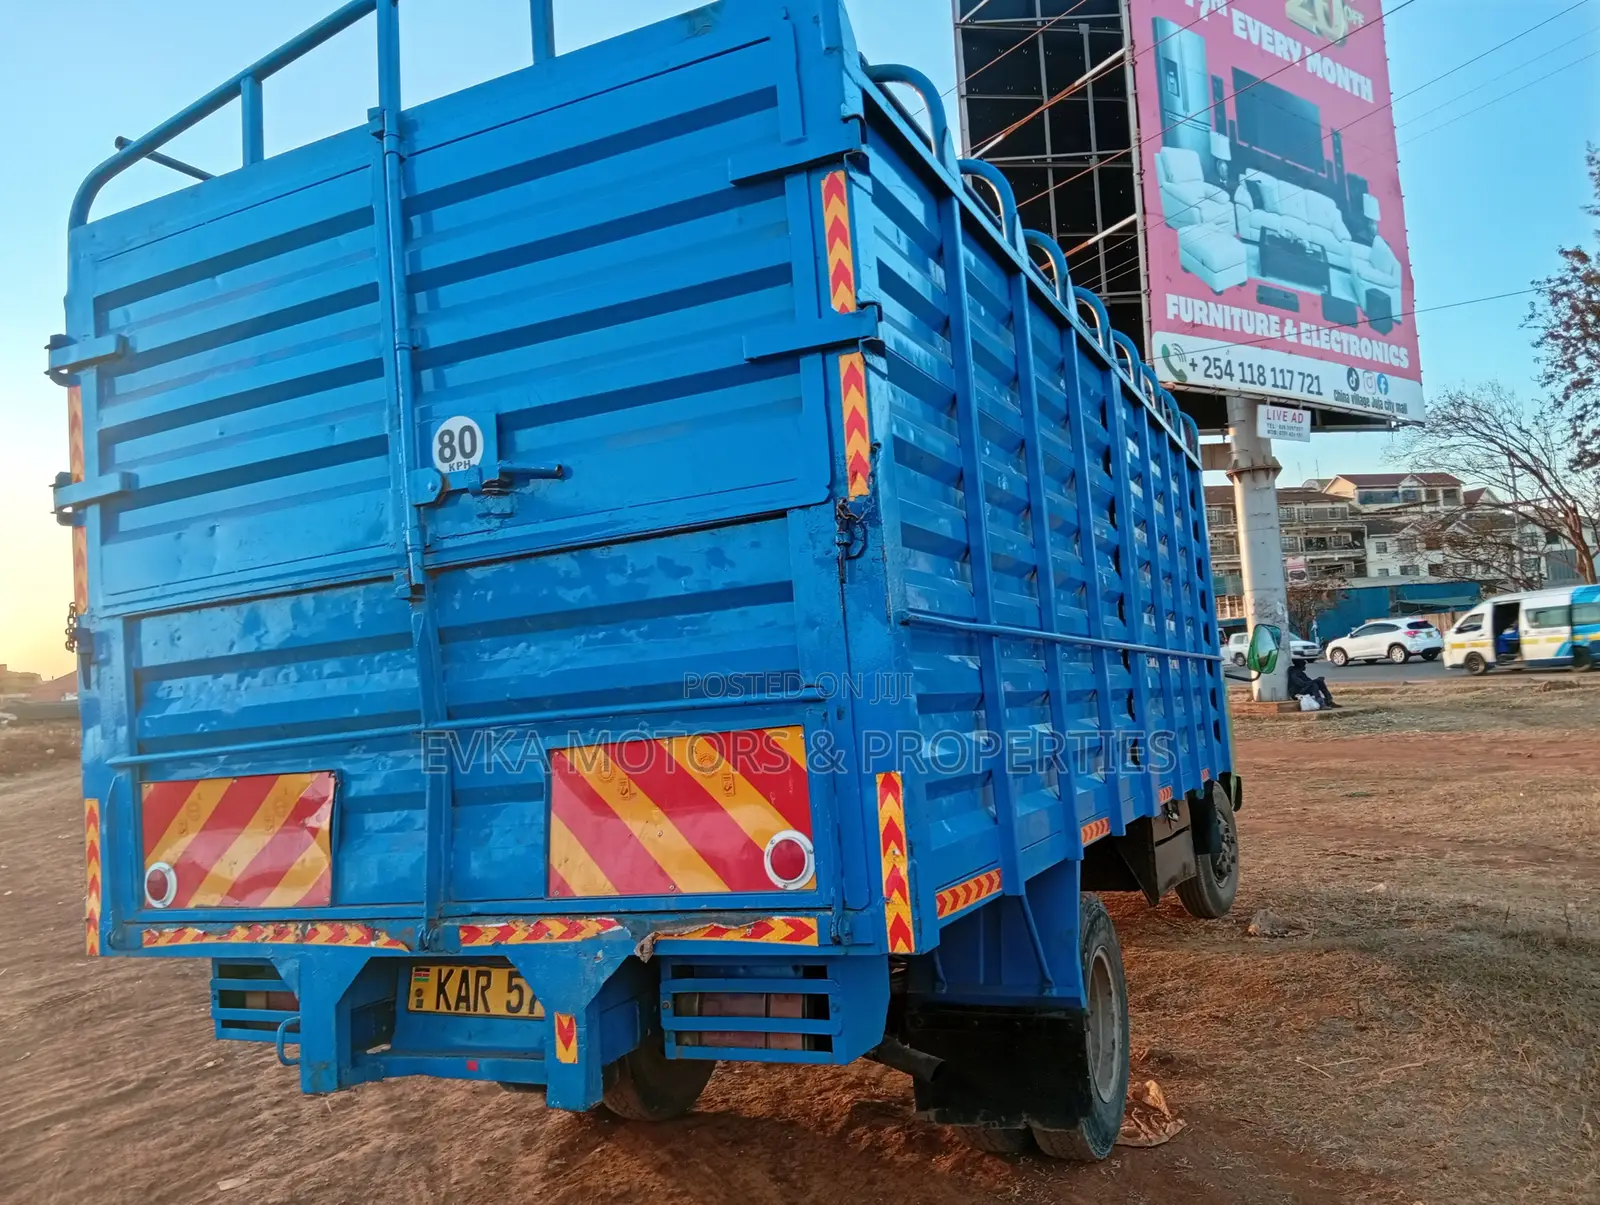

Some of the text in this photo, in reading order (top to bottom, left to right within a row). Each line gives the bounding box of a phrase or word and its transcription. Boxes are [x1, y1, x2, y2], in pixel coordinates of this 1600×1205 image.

[1231, 8, 1302, 66] EVERY
[1305, 46, 1374, 103] MONTH
[1166, 293, 1409, 369] FURNITURE & ELECTRONICS
[1203, 356, 1235, 382] 254
[1238, 361, 1267, 386] 118
[1270, 367, 1295, 391] 117
[1298, 371, 1323, 396] 721
[1334, 389, 1350, 404] China
[1266, 409, 1304, 424] LIVE AD
[438, 425, 477, 463] 80
[448, 460, 471, 472] KPH
[435, 968, 492, 1012] KAR
